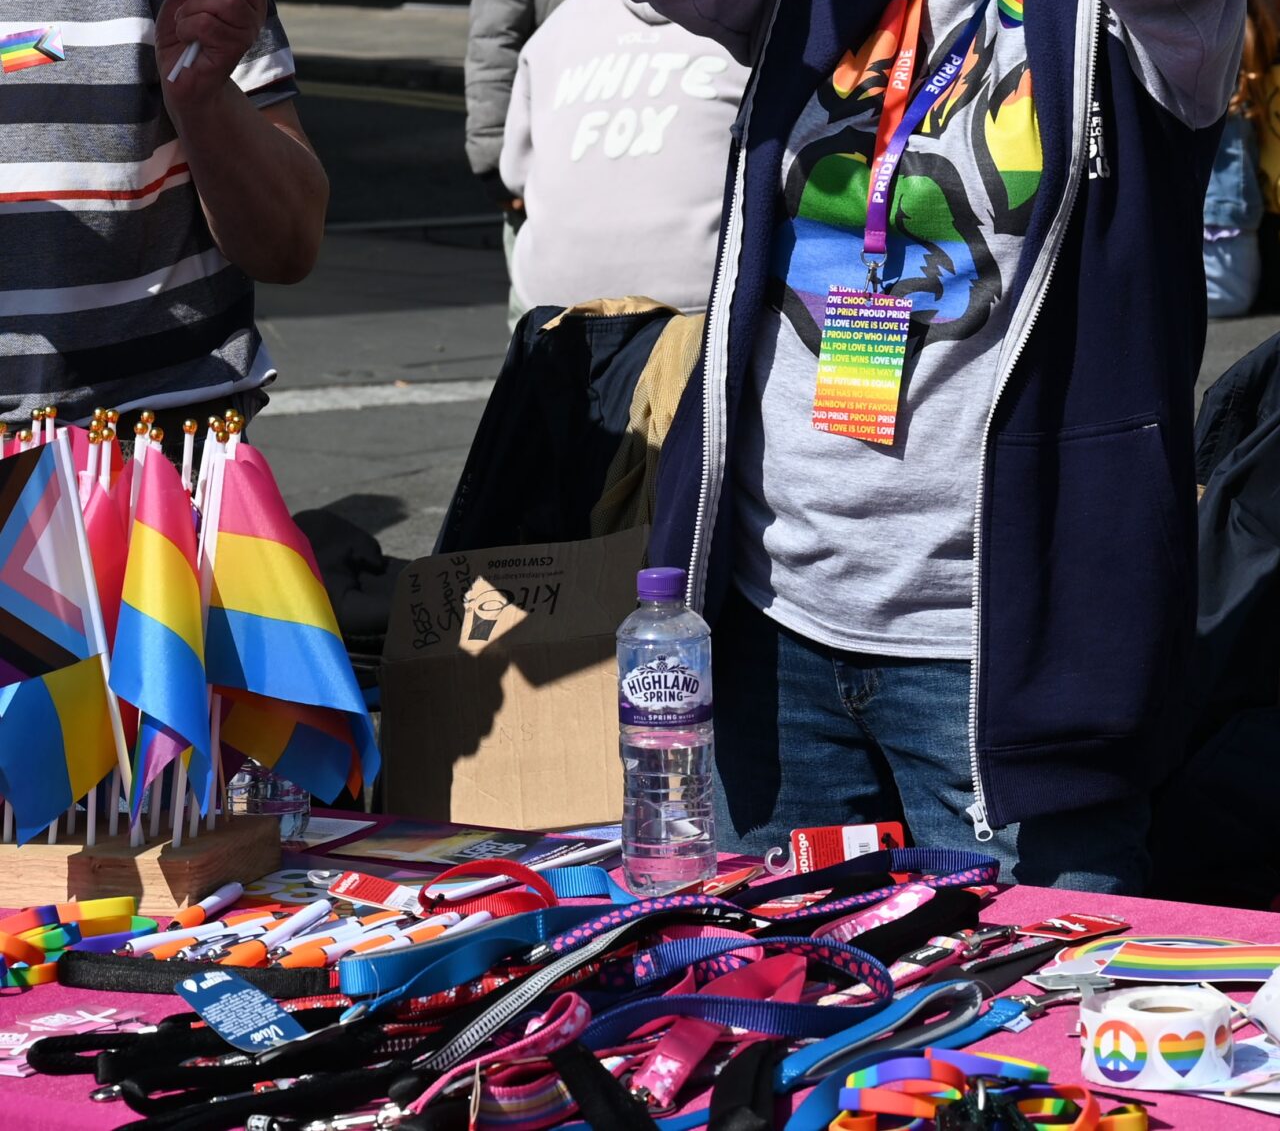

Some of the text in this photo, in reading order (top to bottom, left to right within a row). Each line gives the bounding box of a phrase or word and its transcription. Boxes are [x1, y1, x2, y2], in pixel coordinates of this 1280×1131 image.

[892, 48, 912, 91] PRIDE
[925, 53, 963, 95] PRIDE
[553, 52, 729, 111] WHITE
[571, 105, 679, 162] FOX
[872, 153, 898, 203] PRIDE
[842, 296, 873, 306] CHOOE
[874, 298, 894, 307] LOVE
[837, 308, 858, 316] PRIDE
[859, 309, 886, 318] PROUD
[887, 311, 911, 319] PRIDE
[832, 319, 850, 328] LOVE
[851, 320, 869, 329] LOVE
[870, 321, 878, 329] IS
[879, 322, 898, 331] LOVE
[827, 331, 852, 339] PROUD
[852, 332, 864, 340] OF
[864, 333, 882, 341] WHO
[887, 334, 901, 342] AM
[832, 342, 847, 351] FOR
[847, 343, 866, 352] LOVE
[874, 345, 894, 353] LOVE
[832, 354, 849, 362] LOVE
[850, 354, 869, 363] WINS
[870, 356, 890, 365] LOVE
[847, 400, 855, 409] IS
[855, 401, 868, 410] MY
[828, 411, 849, 420] PRIDE
[850, 413, 876, 422] PROUD
[830, 423, 847, 432] LOVE
[848, 424, 856, 433] IS
[857, 425, 876, 434] LOVE
[487, 556, 554, 569] CSW100806
[408, 573, 441, 650] BEST IN
[627, 675, 700, 696] HIGHLAND
[643, 690, 683, 702] SPRING
